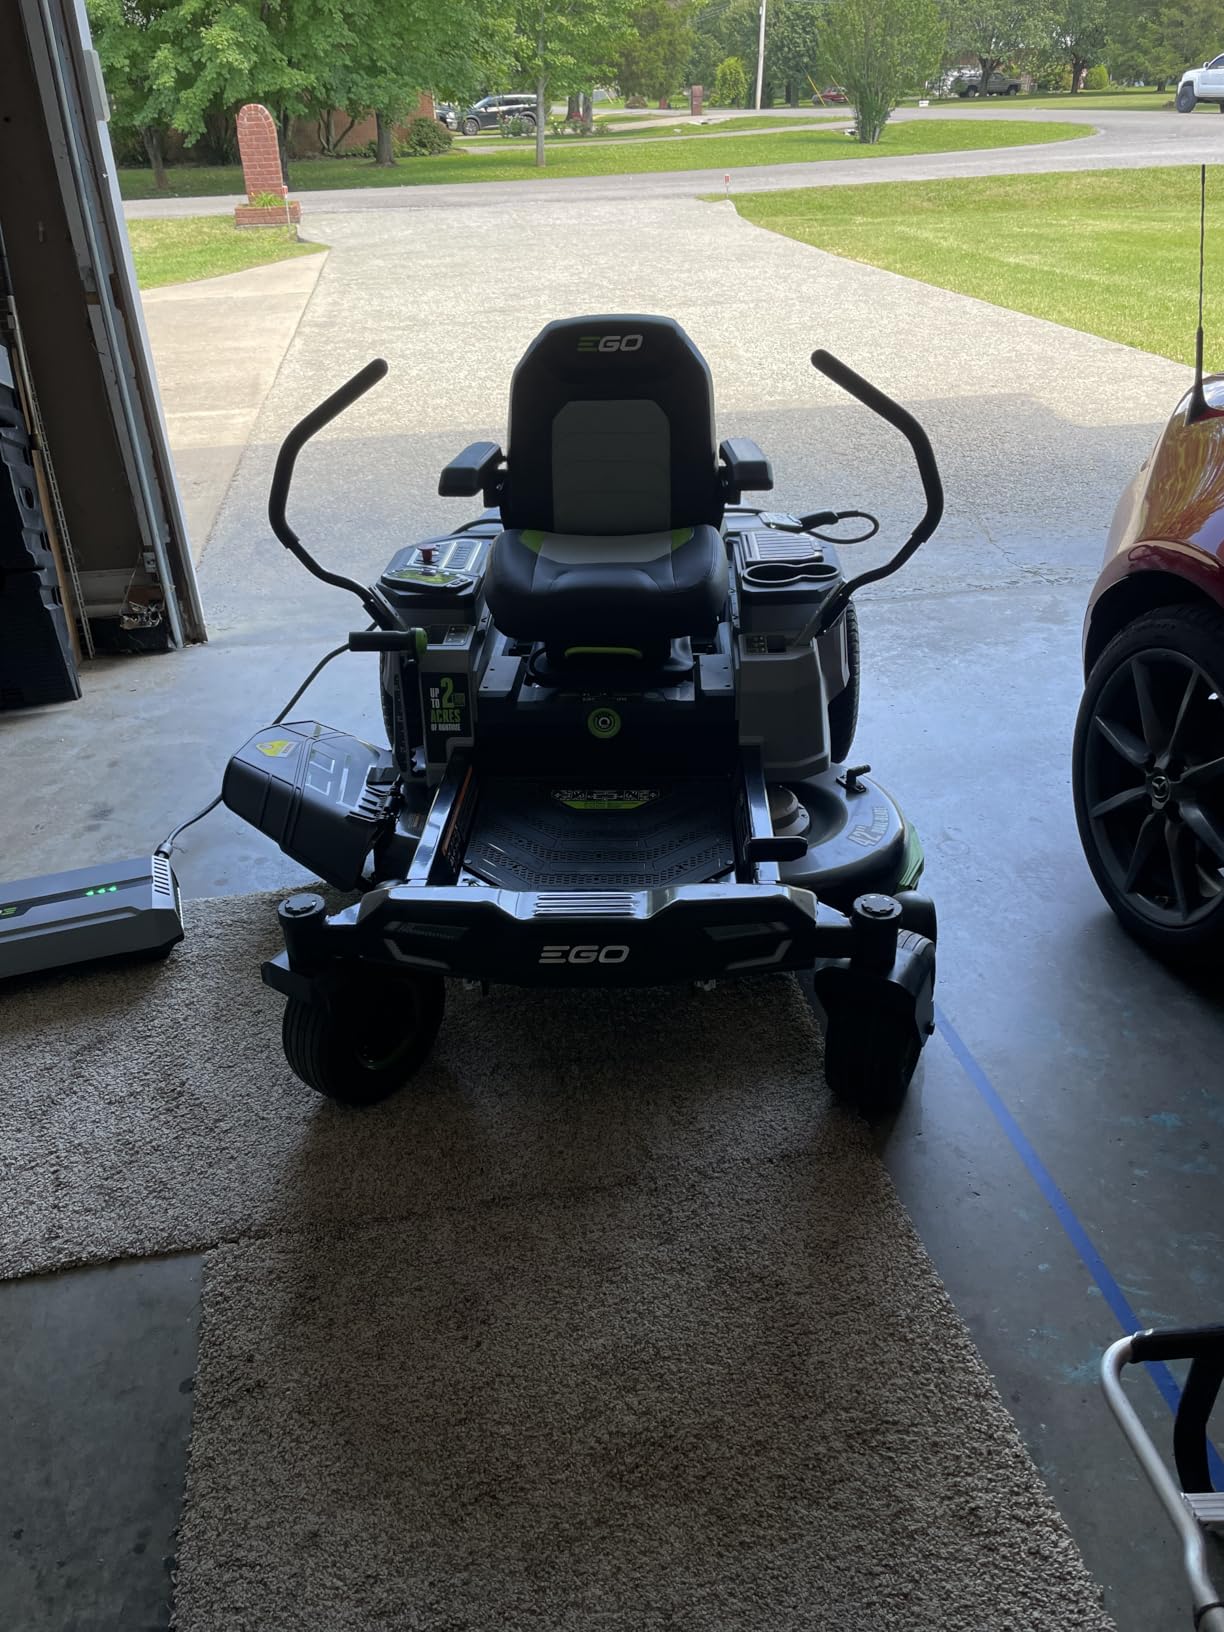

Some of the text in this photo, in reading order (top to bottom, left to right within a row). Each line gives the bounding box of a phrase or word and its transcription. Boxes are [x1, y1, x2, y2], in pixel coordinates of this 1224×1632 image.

[577, 334, 643, 352] EGO
[429, 687, 440, 698] UP
[440, 677, 455, 709] 2
[430, 698, 440, 709] TO
[431, 709, 461, 722] ACRES
[538, 945, 630, 963] EGO
